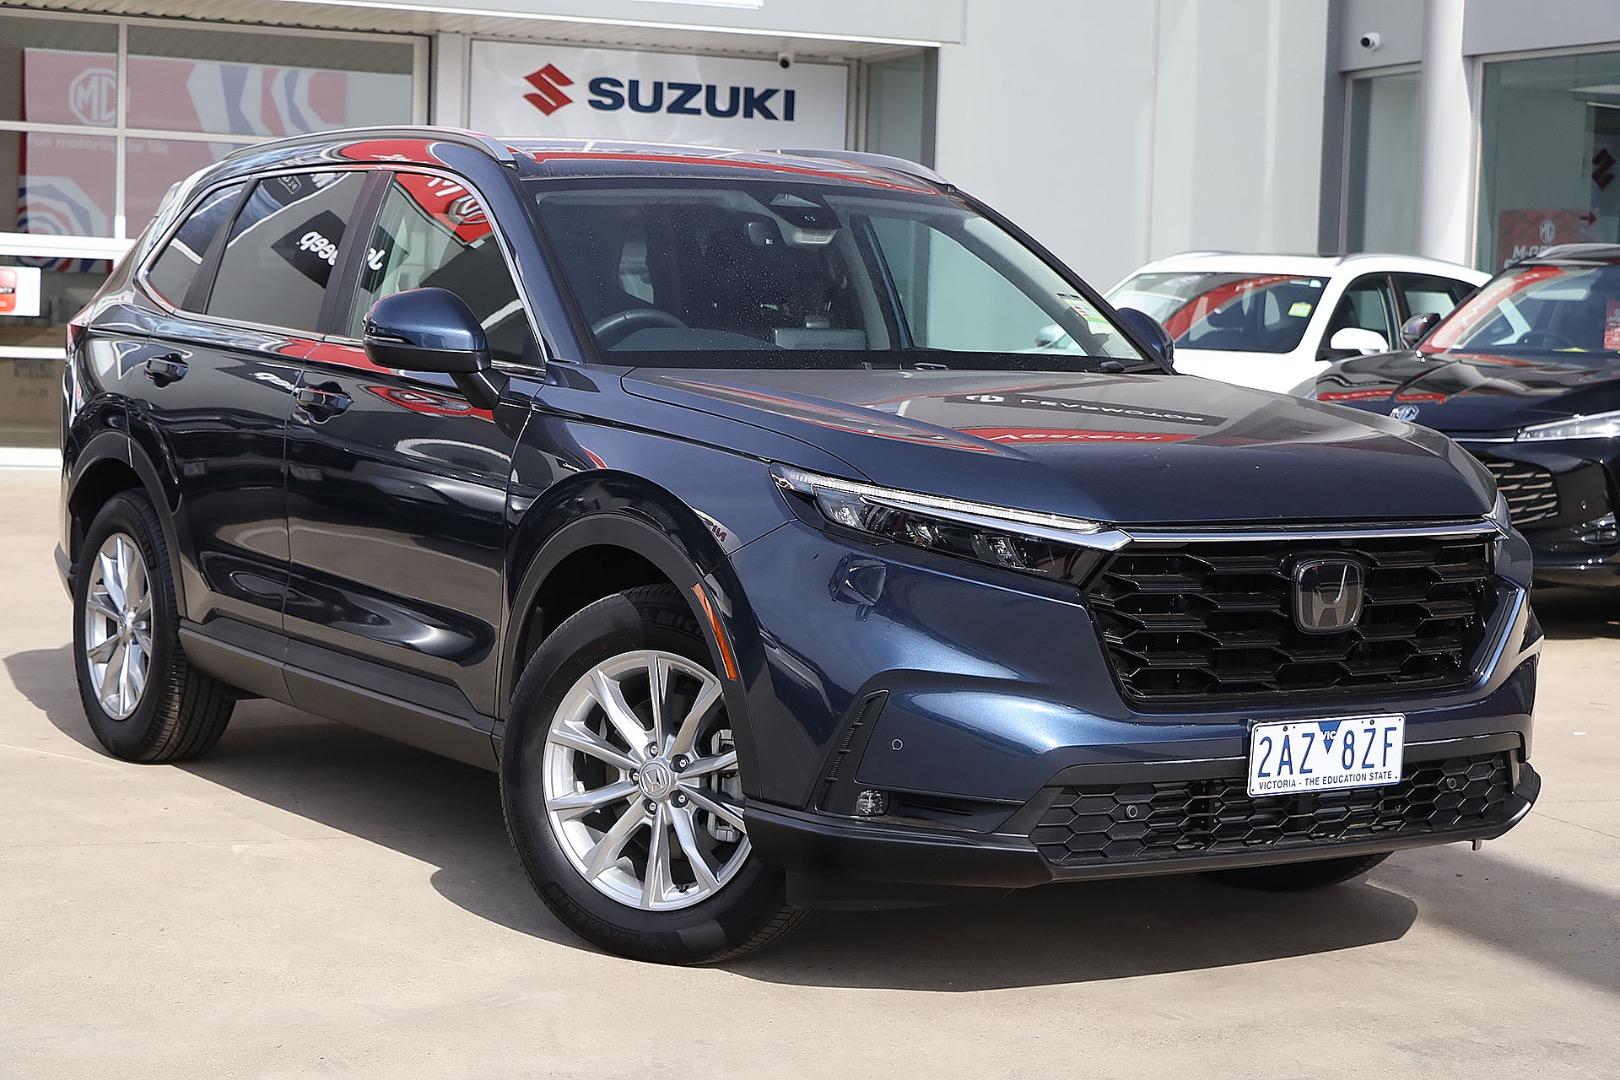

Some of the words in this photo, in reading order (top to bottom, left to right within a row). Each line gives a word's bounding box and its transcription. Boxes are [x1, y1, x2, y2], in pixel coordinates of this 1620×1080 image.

[588, 76, 796, 121] SUZUKI
[1321, 730, 1337, 741] VIC
[1257, 732, 1315, 778] 2AZ
[1341, 726, 1397, 771] 8ZF
[1259, 780, 1296, 790] VICTORIA
[1305, 777, 1320, 787] THE
[1322, 773, 1367, 785] EDUCATION
[1369, 771, 1392, 782] STATE
